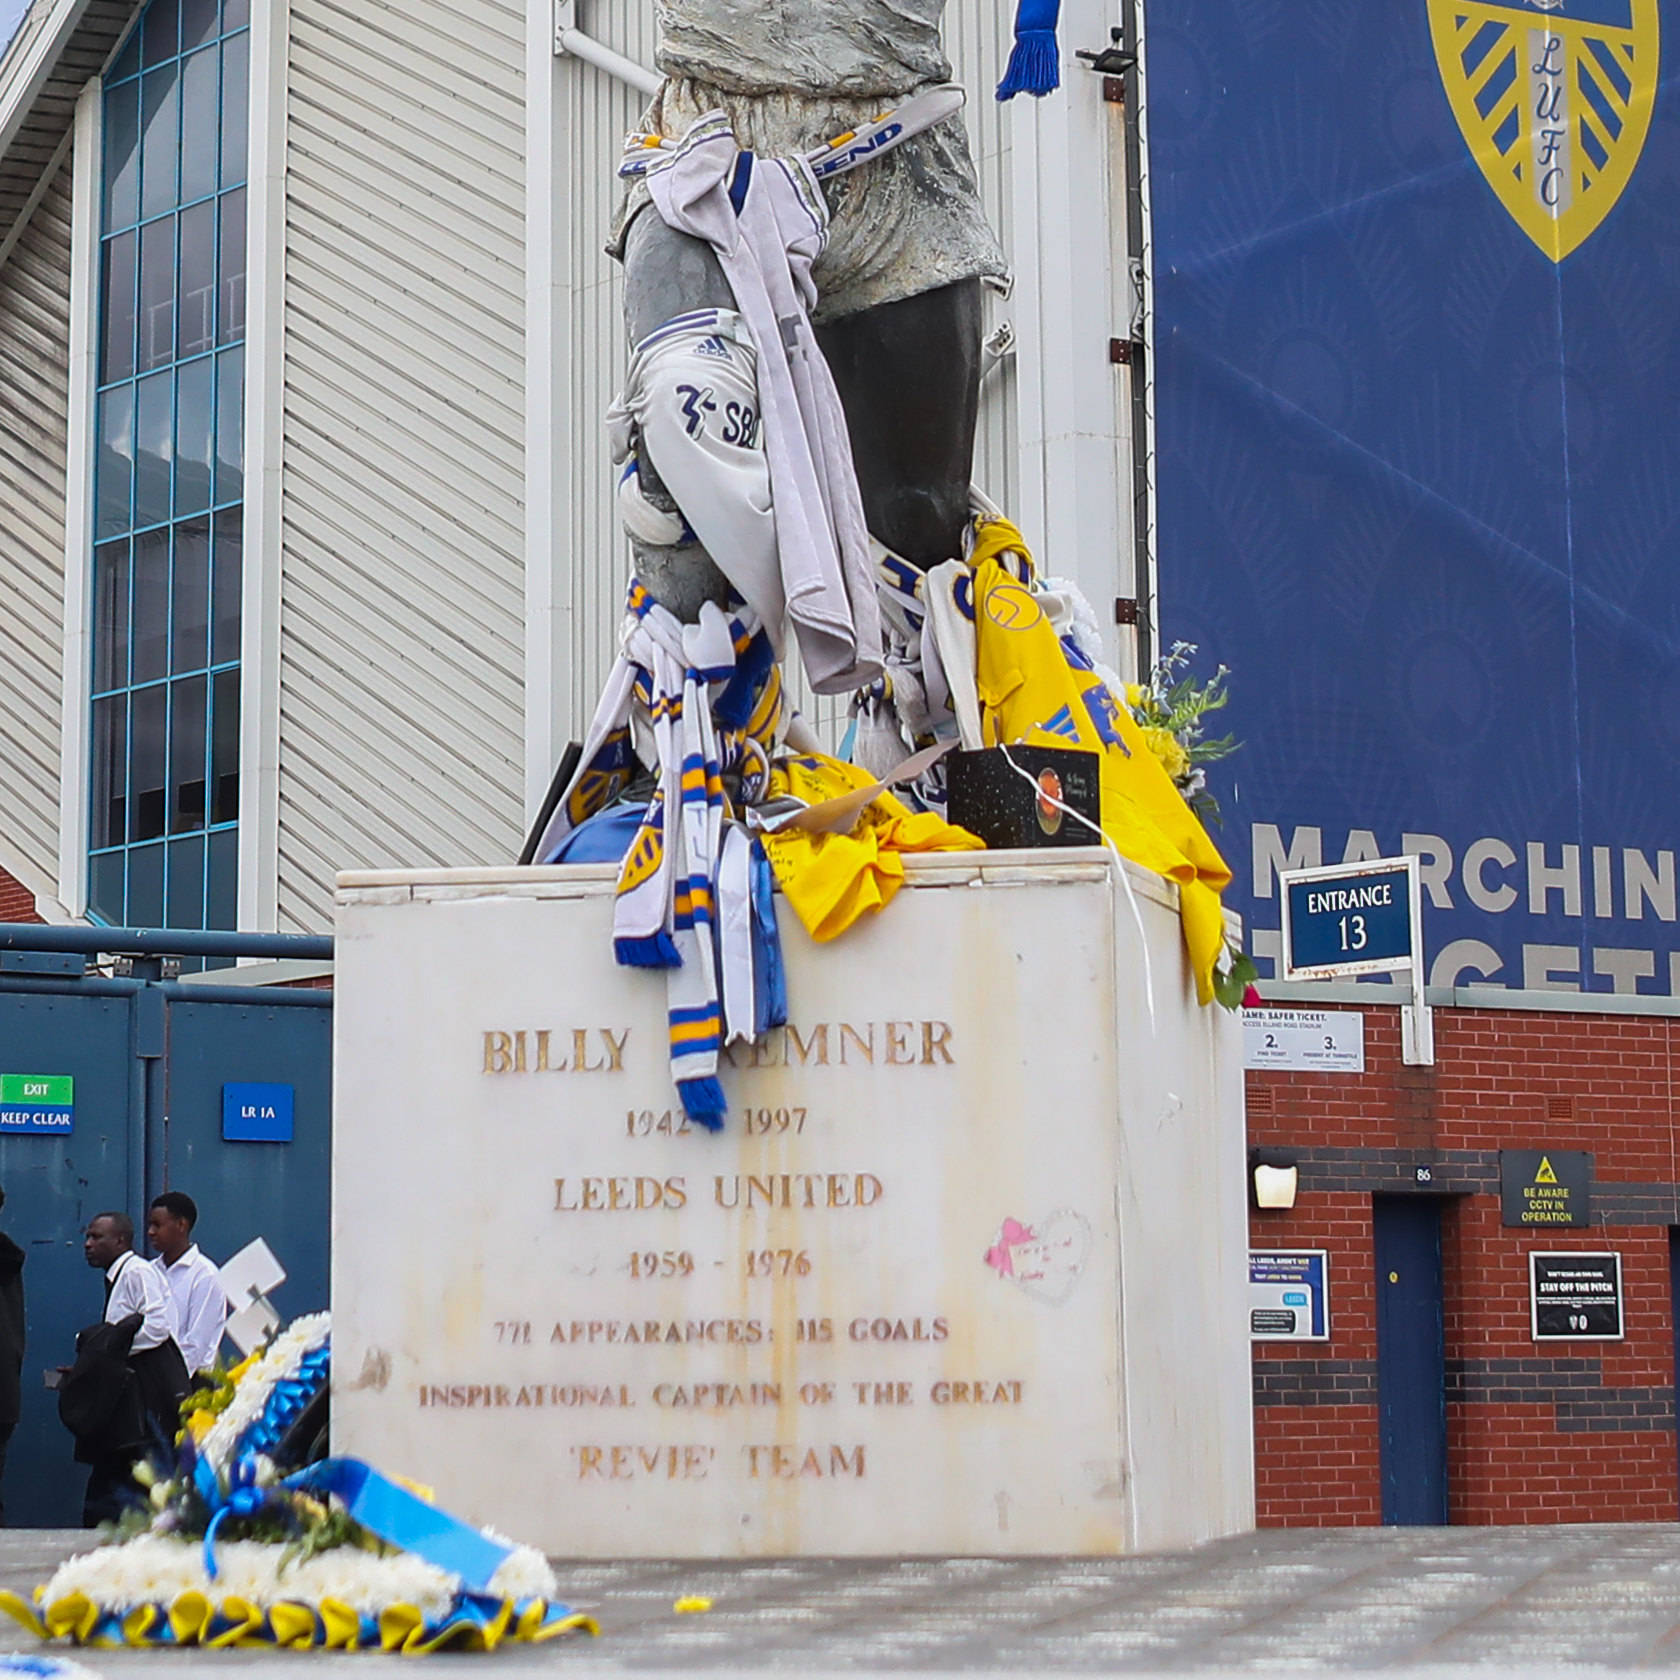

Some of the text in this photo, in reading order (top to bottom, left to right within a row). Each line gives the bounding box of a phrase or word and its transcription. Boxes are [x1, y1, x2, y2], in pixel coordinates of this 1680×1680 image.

[1308, 884, 1392, 914] ENTRANCE
[1338, 915, 1368, 951] 13
[482, 1020, 956, 1074] BILLY EMNER
[1265, 1034, 1278, 1048] 2.
[1324, 1036, 1337, 1050] 3.
[23, 1083, 49, 1096] EXIT
[1, 1112, 70, 1126] KEEP CLEAR
[241, 1106, 256, 1118] LR
[626, 1107, 808, 1137] 1942 1997
[1416, 1168, 1431, 1182] 86
[553, 1173, 884, 1212] LEEDS UNITED
[1523, 1187, 1569, 1199] BE AWARE
[1529, 1200, 1564, 1211] CCTV IN
[1521, 1211, 1572, 1223] OPERATION
[627, 1250, 695, 1280] 1959
[745, 1249, 812, 1277] 1976
[1540, 1282, 1614, 1293] STAY OFF THE PITCH
[848, 1317, 950, 1342] GOALS
[419, 1378, 1026, 1409] INSPIRATIONAL CAPTAIN OF THE GREAT
[741, 1443, 867, 1480] TEAM
